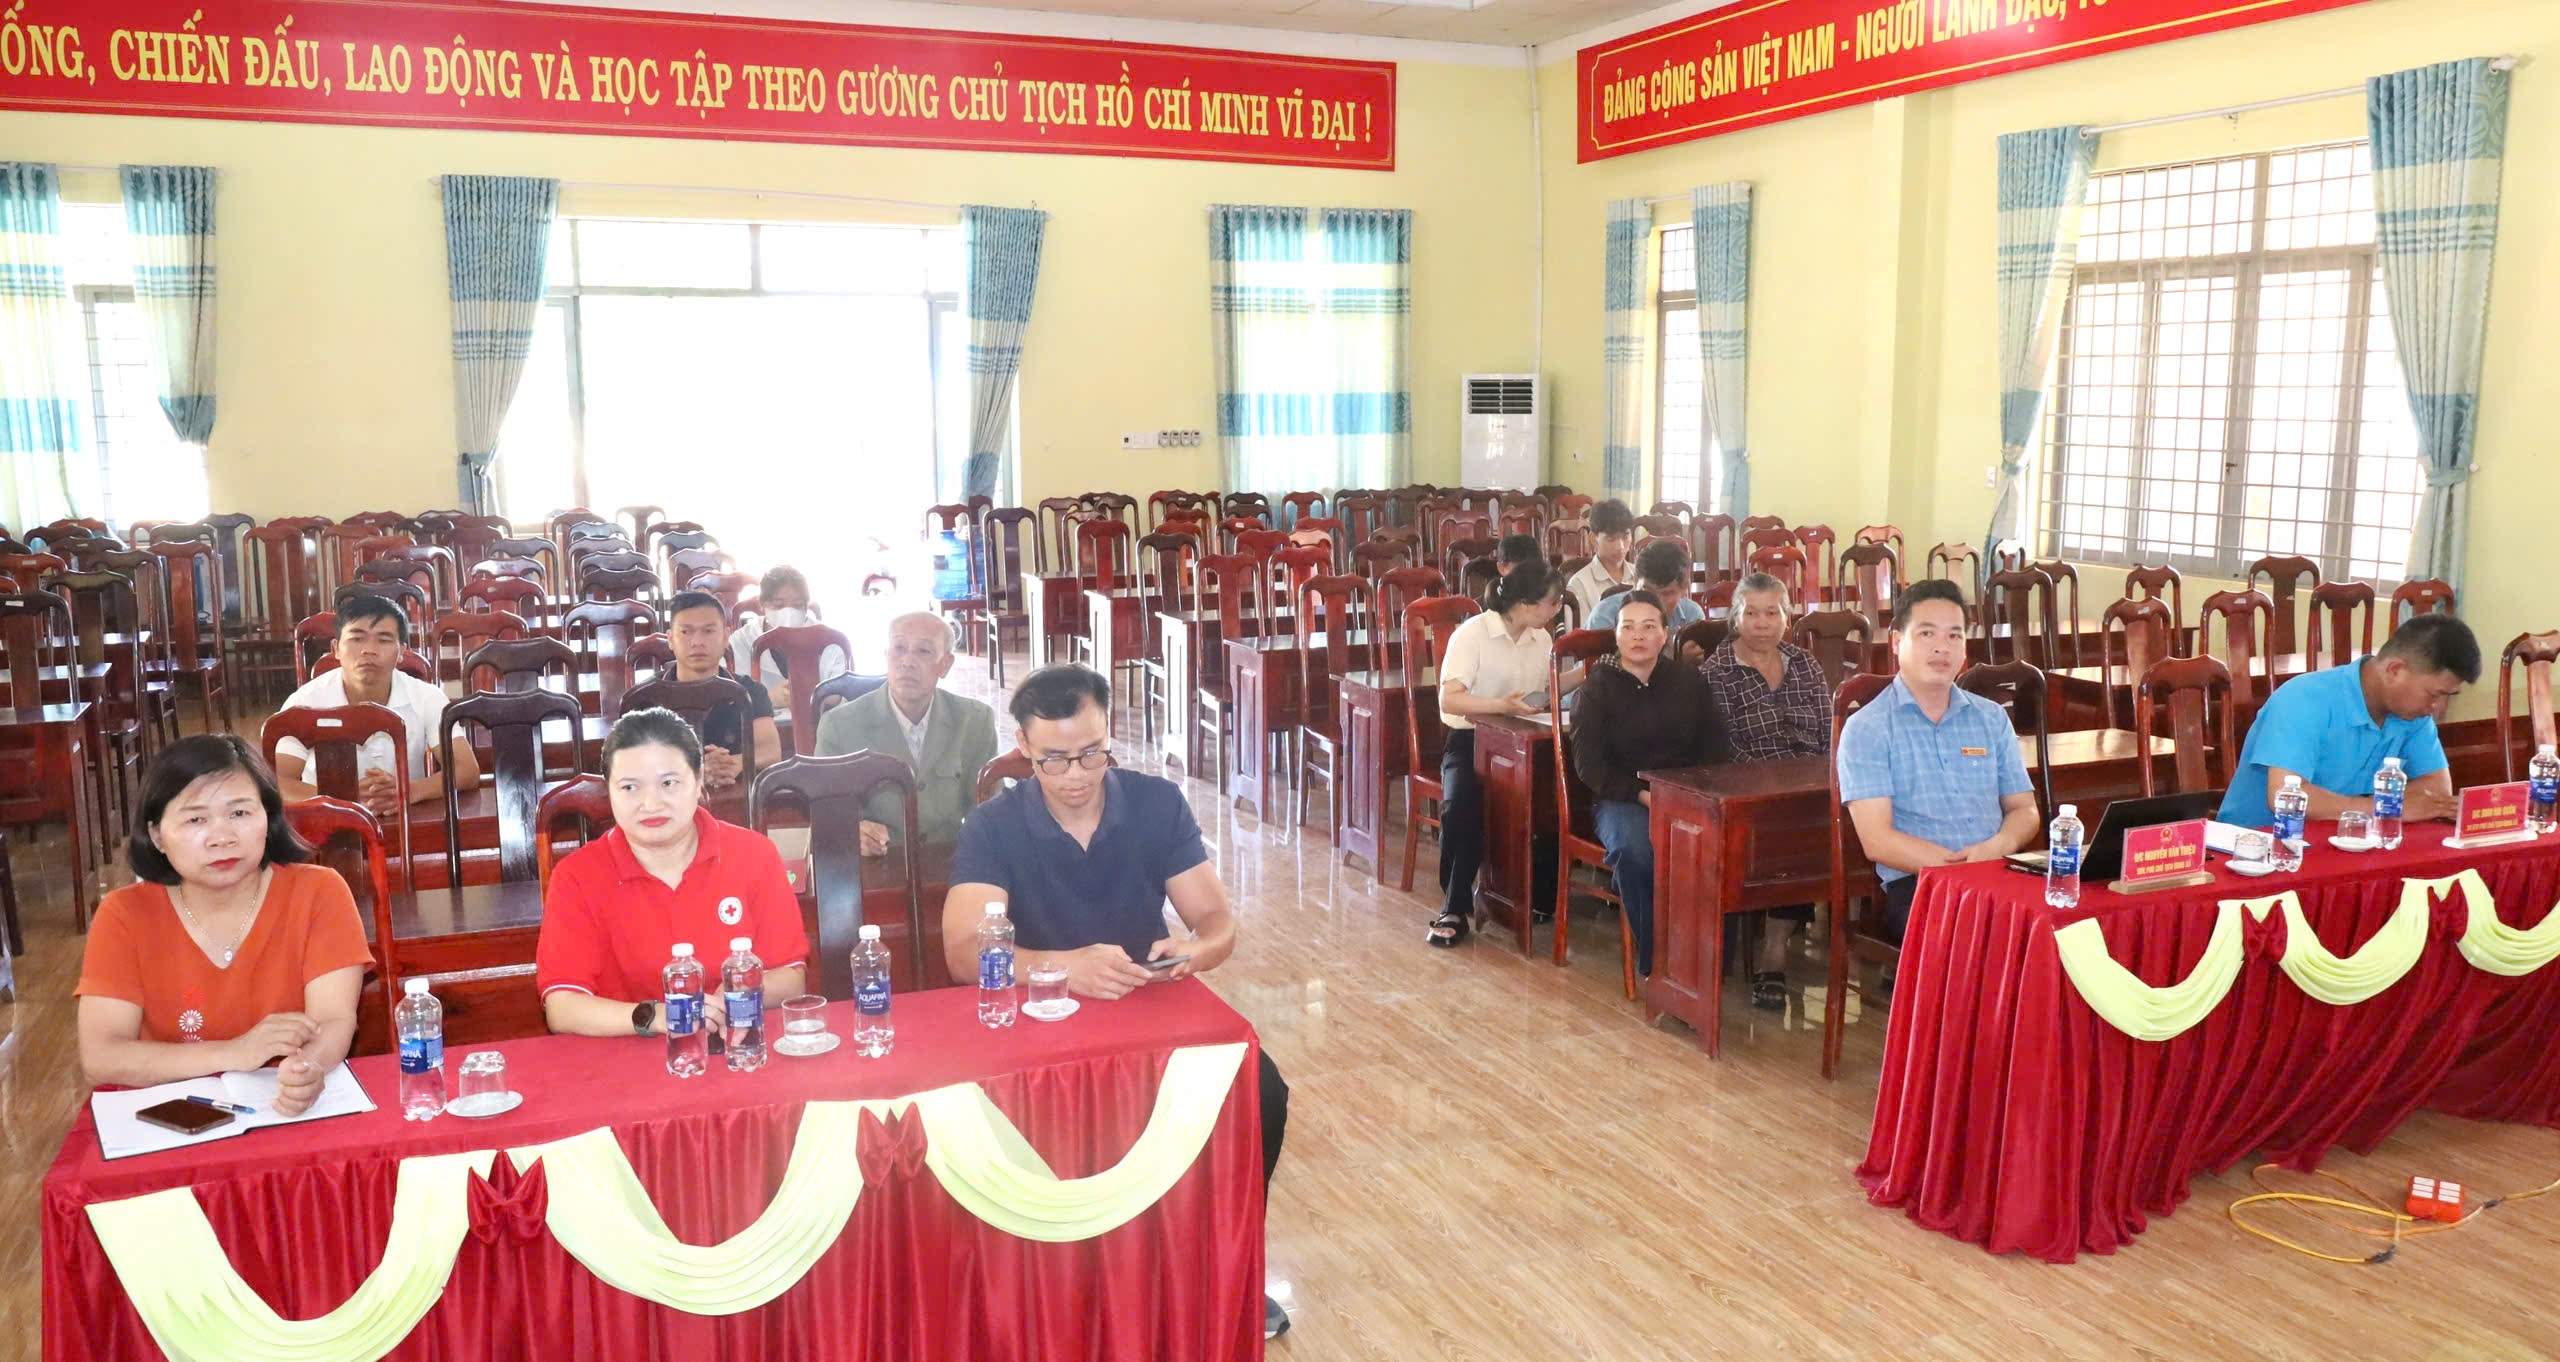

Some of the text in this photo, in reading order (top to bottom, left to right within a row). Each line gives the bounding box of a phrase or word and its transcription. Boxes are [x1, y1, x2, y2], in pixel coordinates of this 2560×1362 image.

[110, 9, 230, 85] CHIẾN
[242, 14, 332, 97] ĐẤU,
[342, 42, 413, 95] LAO
[422, 33, 523, 109] ĐỘNG
[530, 39, 581, 102] VÀ
[588, 55, 661, 116] HỌC
[669, 48, 733, 120] TẬP
[741, 64, 827, 114] THEO
[836, 63, 940, 119] GƯƠNG
[948, 61, 1009, 123] CHỦ
[1018, 79, 1088, 135] TỊCH
[1095, 60, 1134, 129] HỒ
[1143, 77, 1192, 131] CHÍ
[1199, 91, 1269, 136] MINH
[1276, 87, 1304, 139] VĨ
[1311, 99, 1356, 151] ĐẠI
[1365, 103, 1371, 143] !
[1603, 67, 1646, 123] ĐẢNG
[1650, 59, 1696, 118] CỘNG
[1700, 39, 1738, 100] SẢN
[1742, 31, 1783, 95] VIỆT
[1787, 22, 1835, 79] NAM
[858, 991, 887, 1003] AQUAFINA
